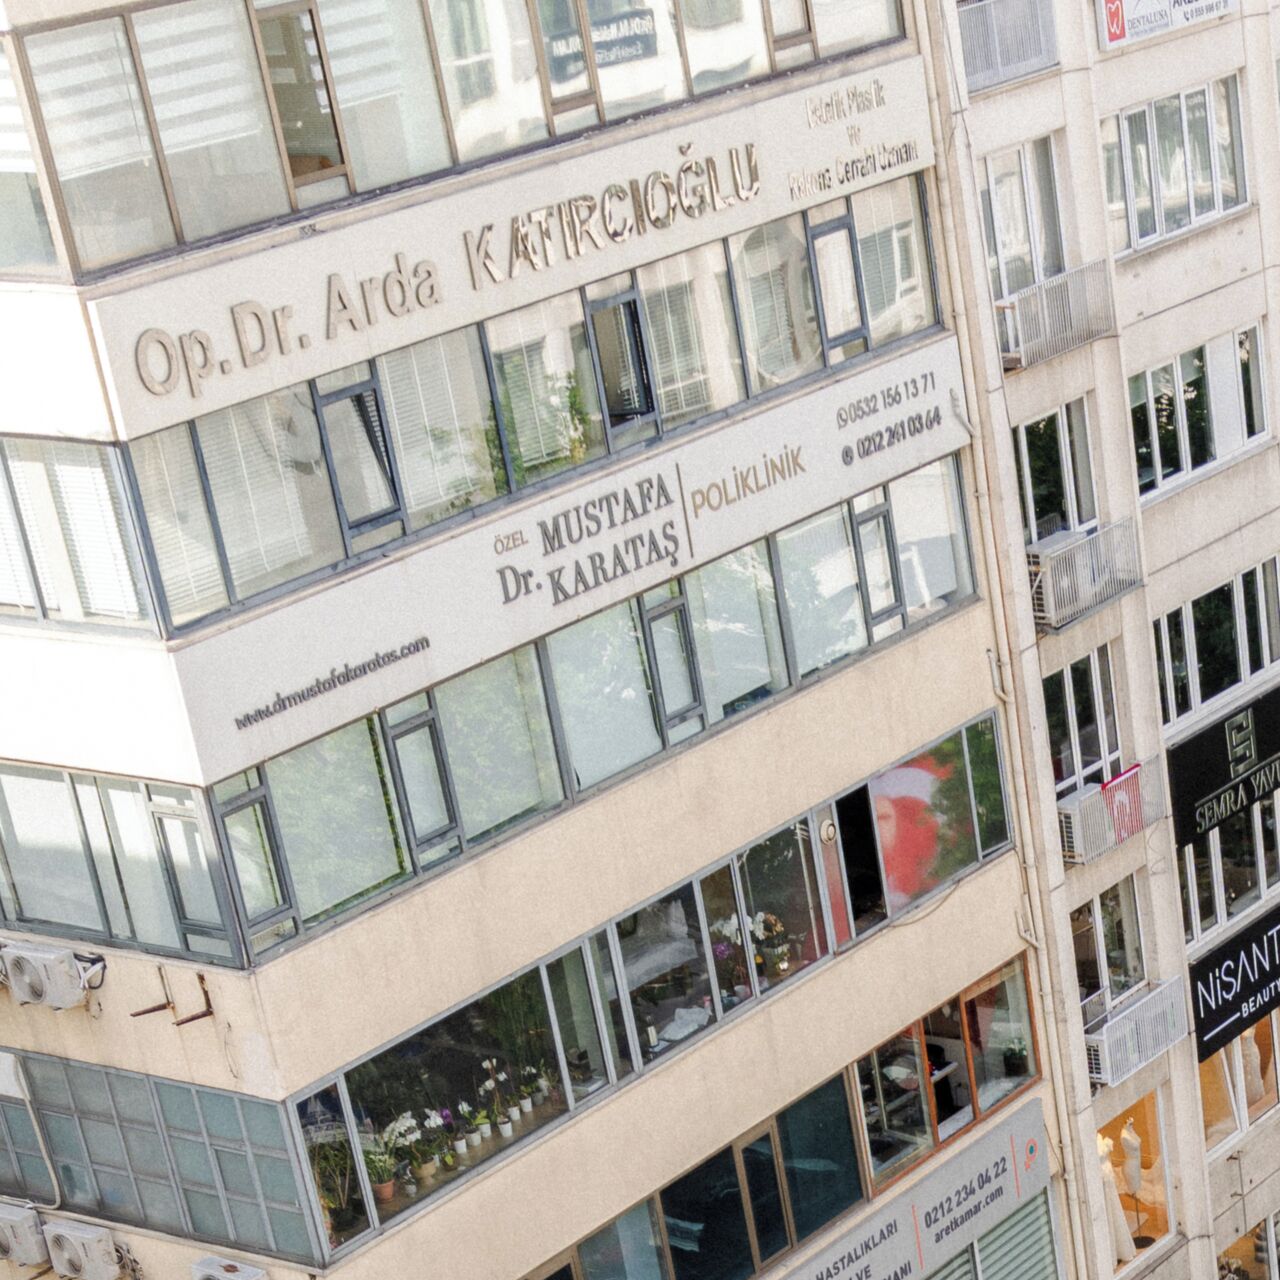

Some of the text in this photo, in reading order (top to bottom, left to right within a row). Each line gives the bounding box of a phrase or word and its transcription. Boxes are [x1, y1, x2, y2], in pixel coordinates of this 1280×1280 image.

[846, 79, 885, 116] Plastik
[835, 145, 877, 185] Cerrahi
[326, 252, 442, 339] Arda
[463, 143, 760, 290] KATIRCIOĞLU
[848, 371, 936, 423] 0532 156 13 71
[856, 405, 942, 459] 0212 241 03 64
[493, 472, 675, 556] ÖZEL MUSTAFA
[690, 444, 807, 519] POLİKLİNİK
[496, 520, 680, 606] Dr. KARATAŞ
[234, 635, 431, 730] www.drmustafakaratas.com
[1195, 783, 1248, 834] SEMRA
[924, 1156, 1008, 1229] 0212 234 04 22
[935, 1185, 1004, 1243] aretkamar.com
